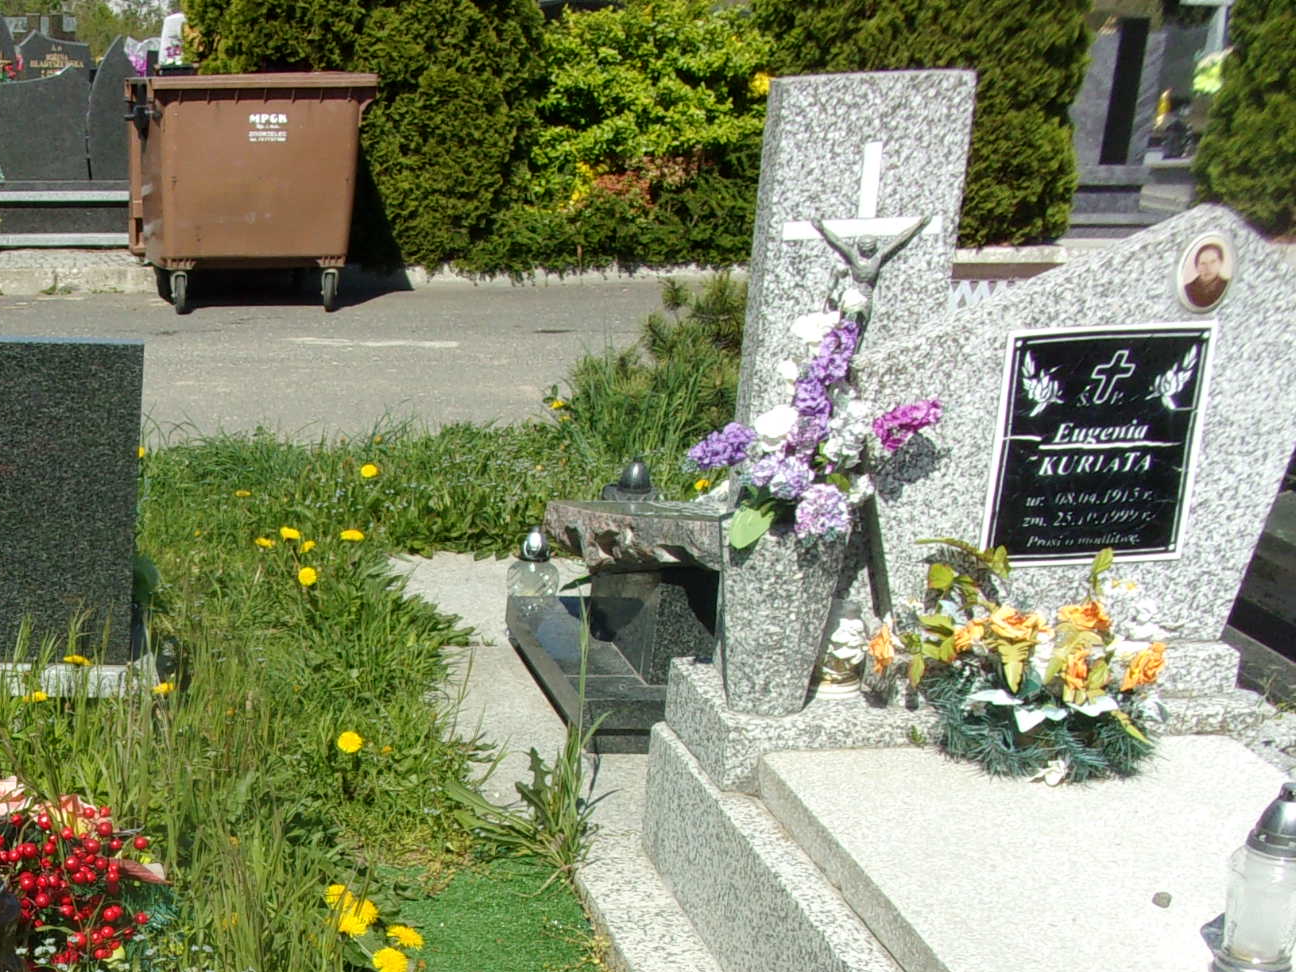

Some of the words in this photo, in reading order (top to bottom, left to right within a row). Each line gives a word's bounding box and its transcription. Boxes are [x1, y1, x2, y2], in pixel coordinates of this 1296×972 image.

[1051, 418, 1149, 444] Eugenia
[1037, 451, 1152, 477] KURIATA
[1021, 515, 1047, 528] zm.
